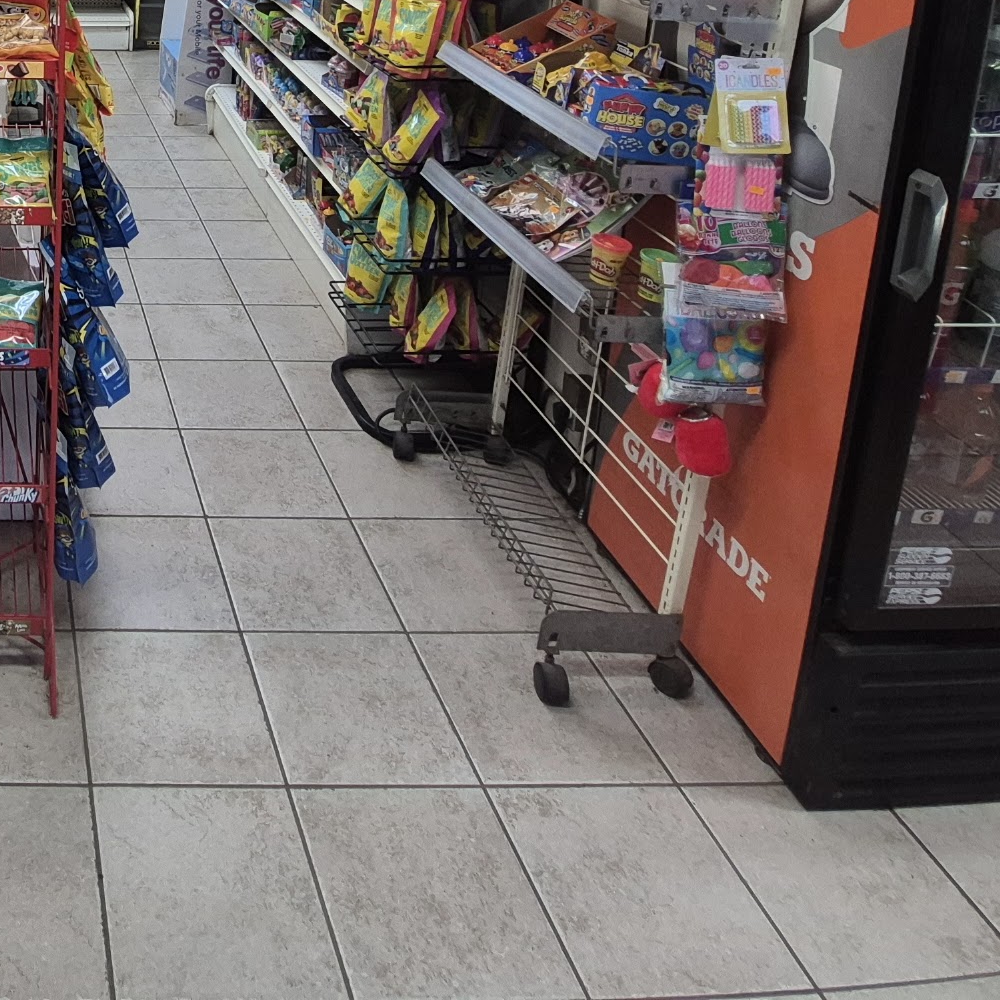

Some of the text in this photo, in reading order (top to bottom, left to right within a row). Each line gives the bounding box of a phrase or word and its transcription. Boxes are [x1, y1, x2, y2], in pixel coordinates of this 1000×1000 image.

[597, 110, 645, 128] HOUSE
[696, 215, 717, 233] 10
[786, 231, 816, 281] S
